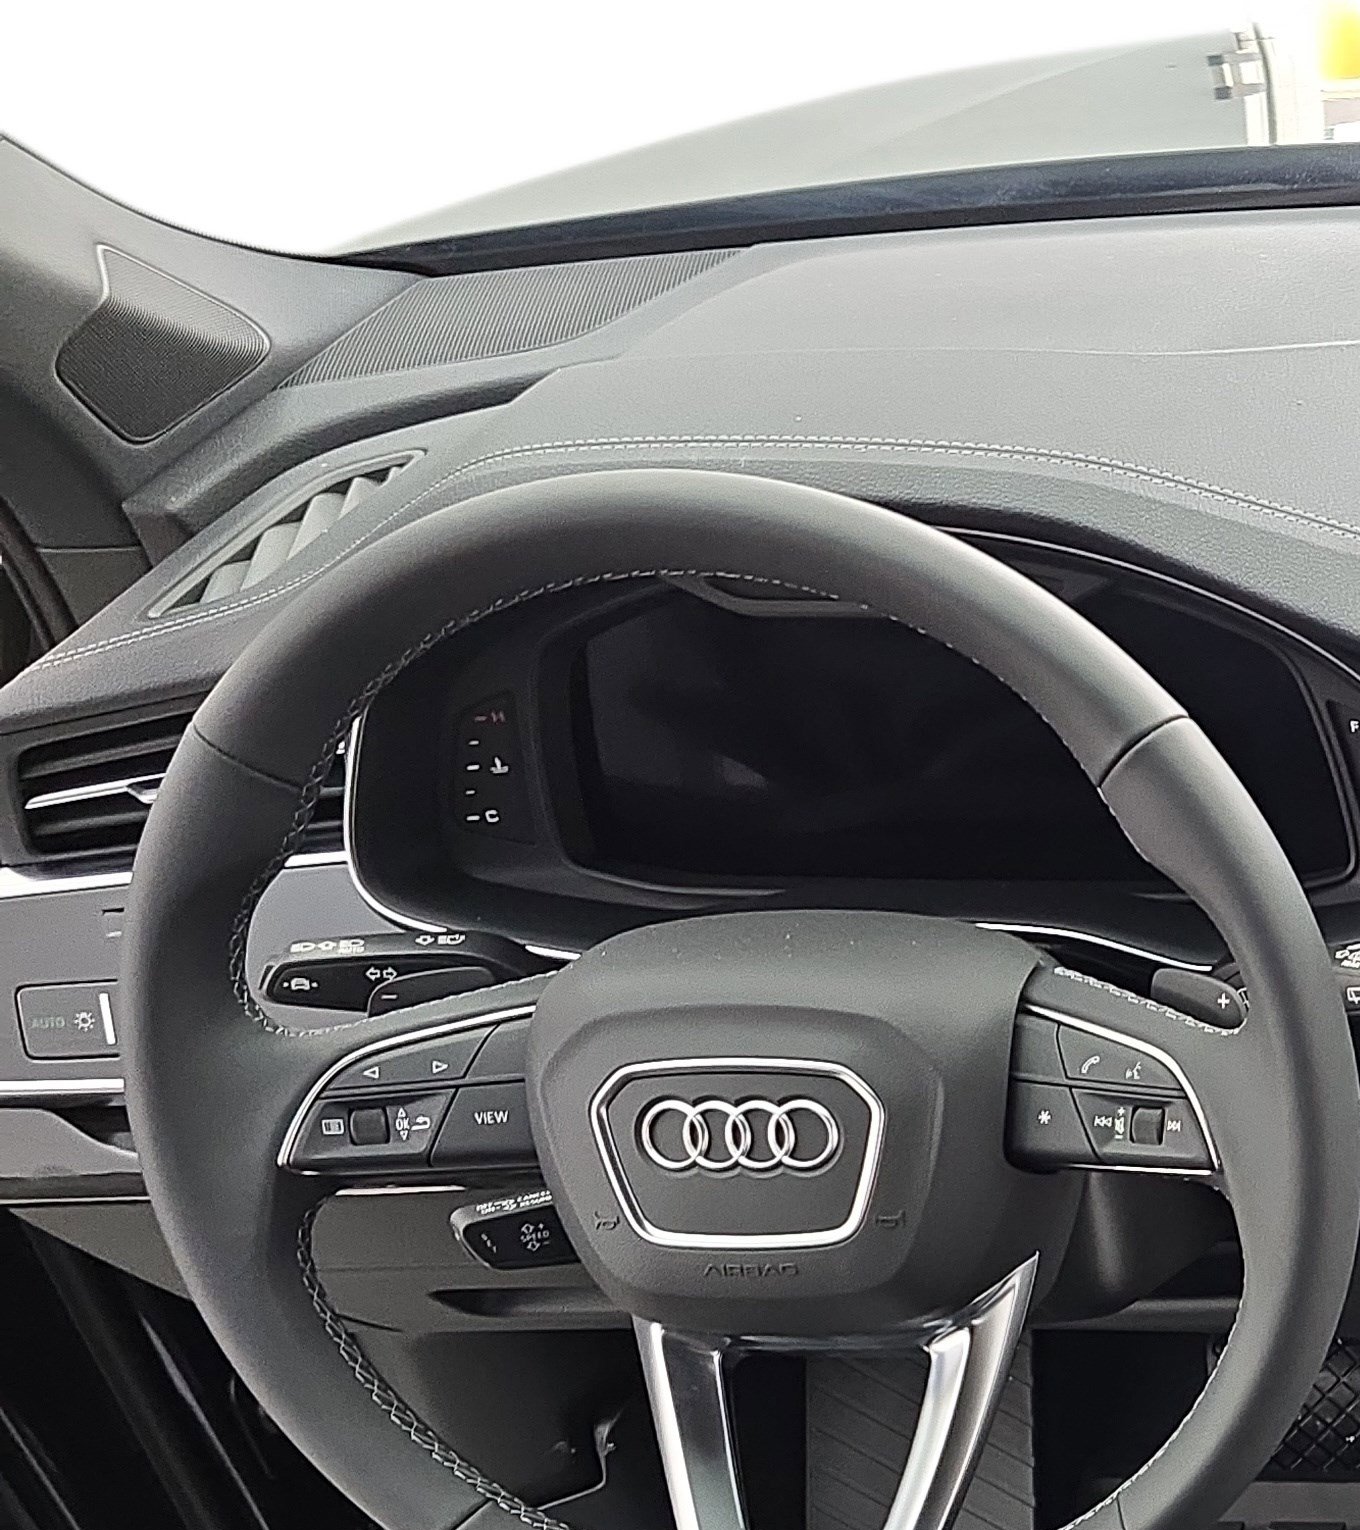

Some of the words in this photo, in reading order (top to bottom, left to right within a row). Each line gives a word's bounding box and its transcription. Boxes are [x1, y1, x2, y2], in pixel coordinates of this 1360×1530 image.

[1350, 720, 1360, 733] F
[485, 809, 500, 823] C
[474, 1110, 509, 1125] VIEW
[395, 1118, 410, 1131] OK
